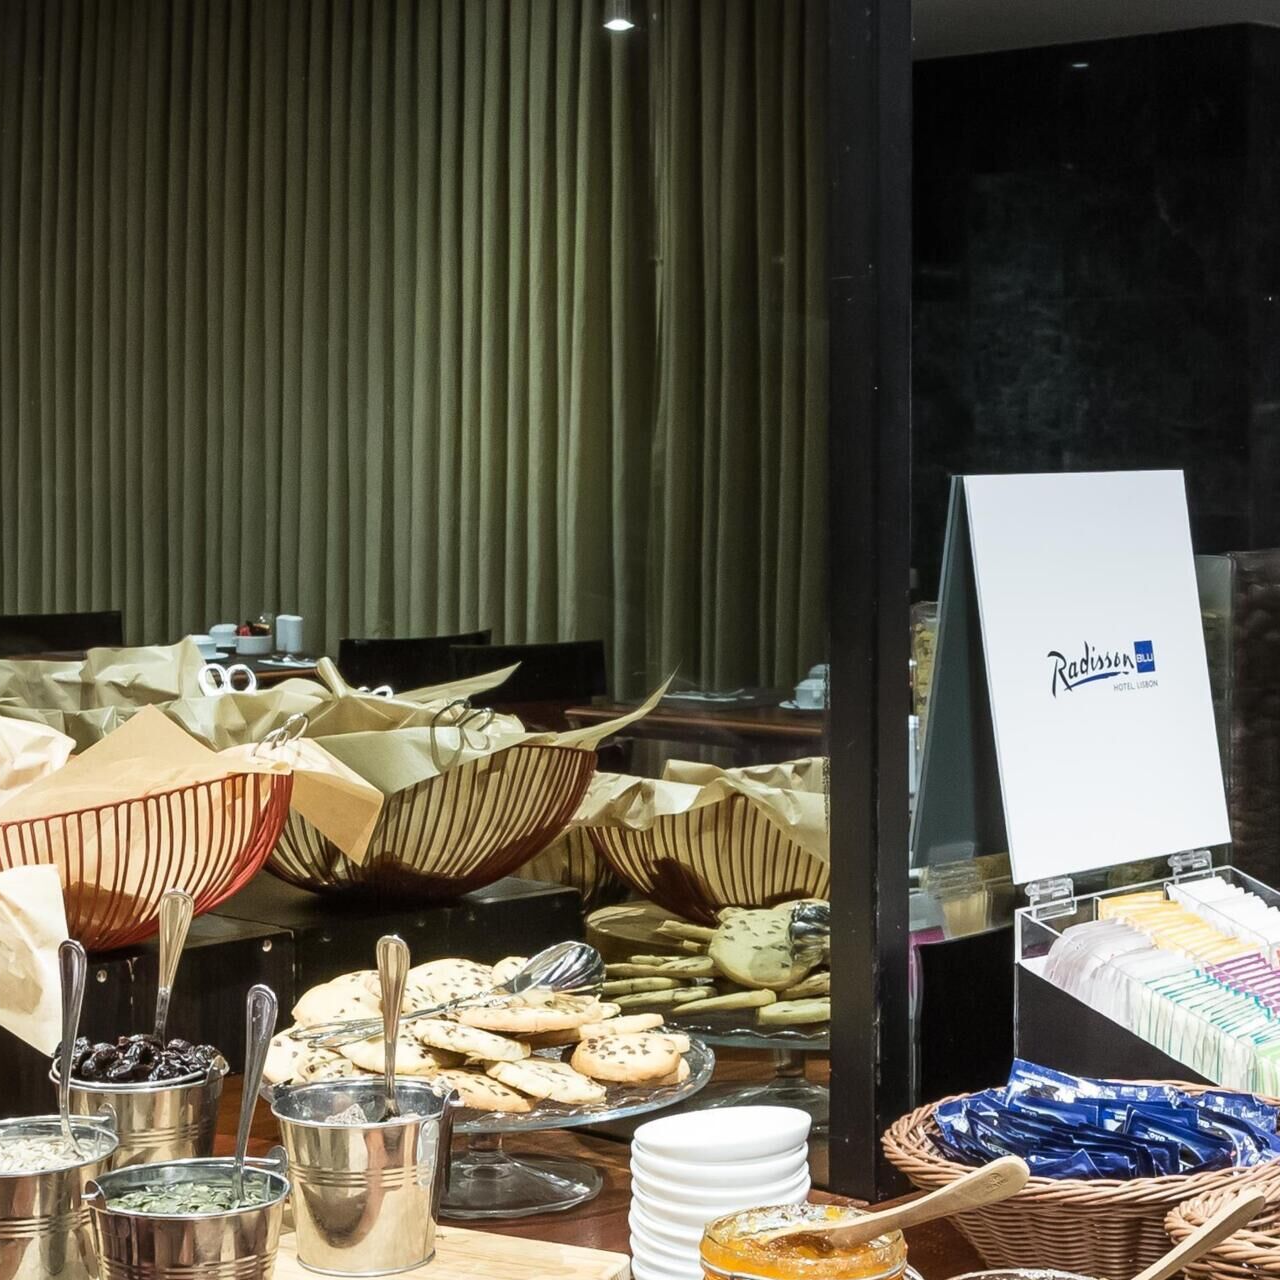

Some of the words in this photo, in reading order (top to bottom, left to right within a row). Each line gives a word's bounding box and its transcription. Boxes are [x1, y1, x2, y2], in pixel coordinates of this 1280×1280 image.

[1047, 640, 1134, 698] Radisson
[1136, 653, 1153, 663] BLU
[1113, 682, 1135, 692] HOTEL
[1136, 680, 1159, 689] LISBON
